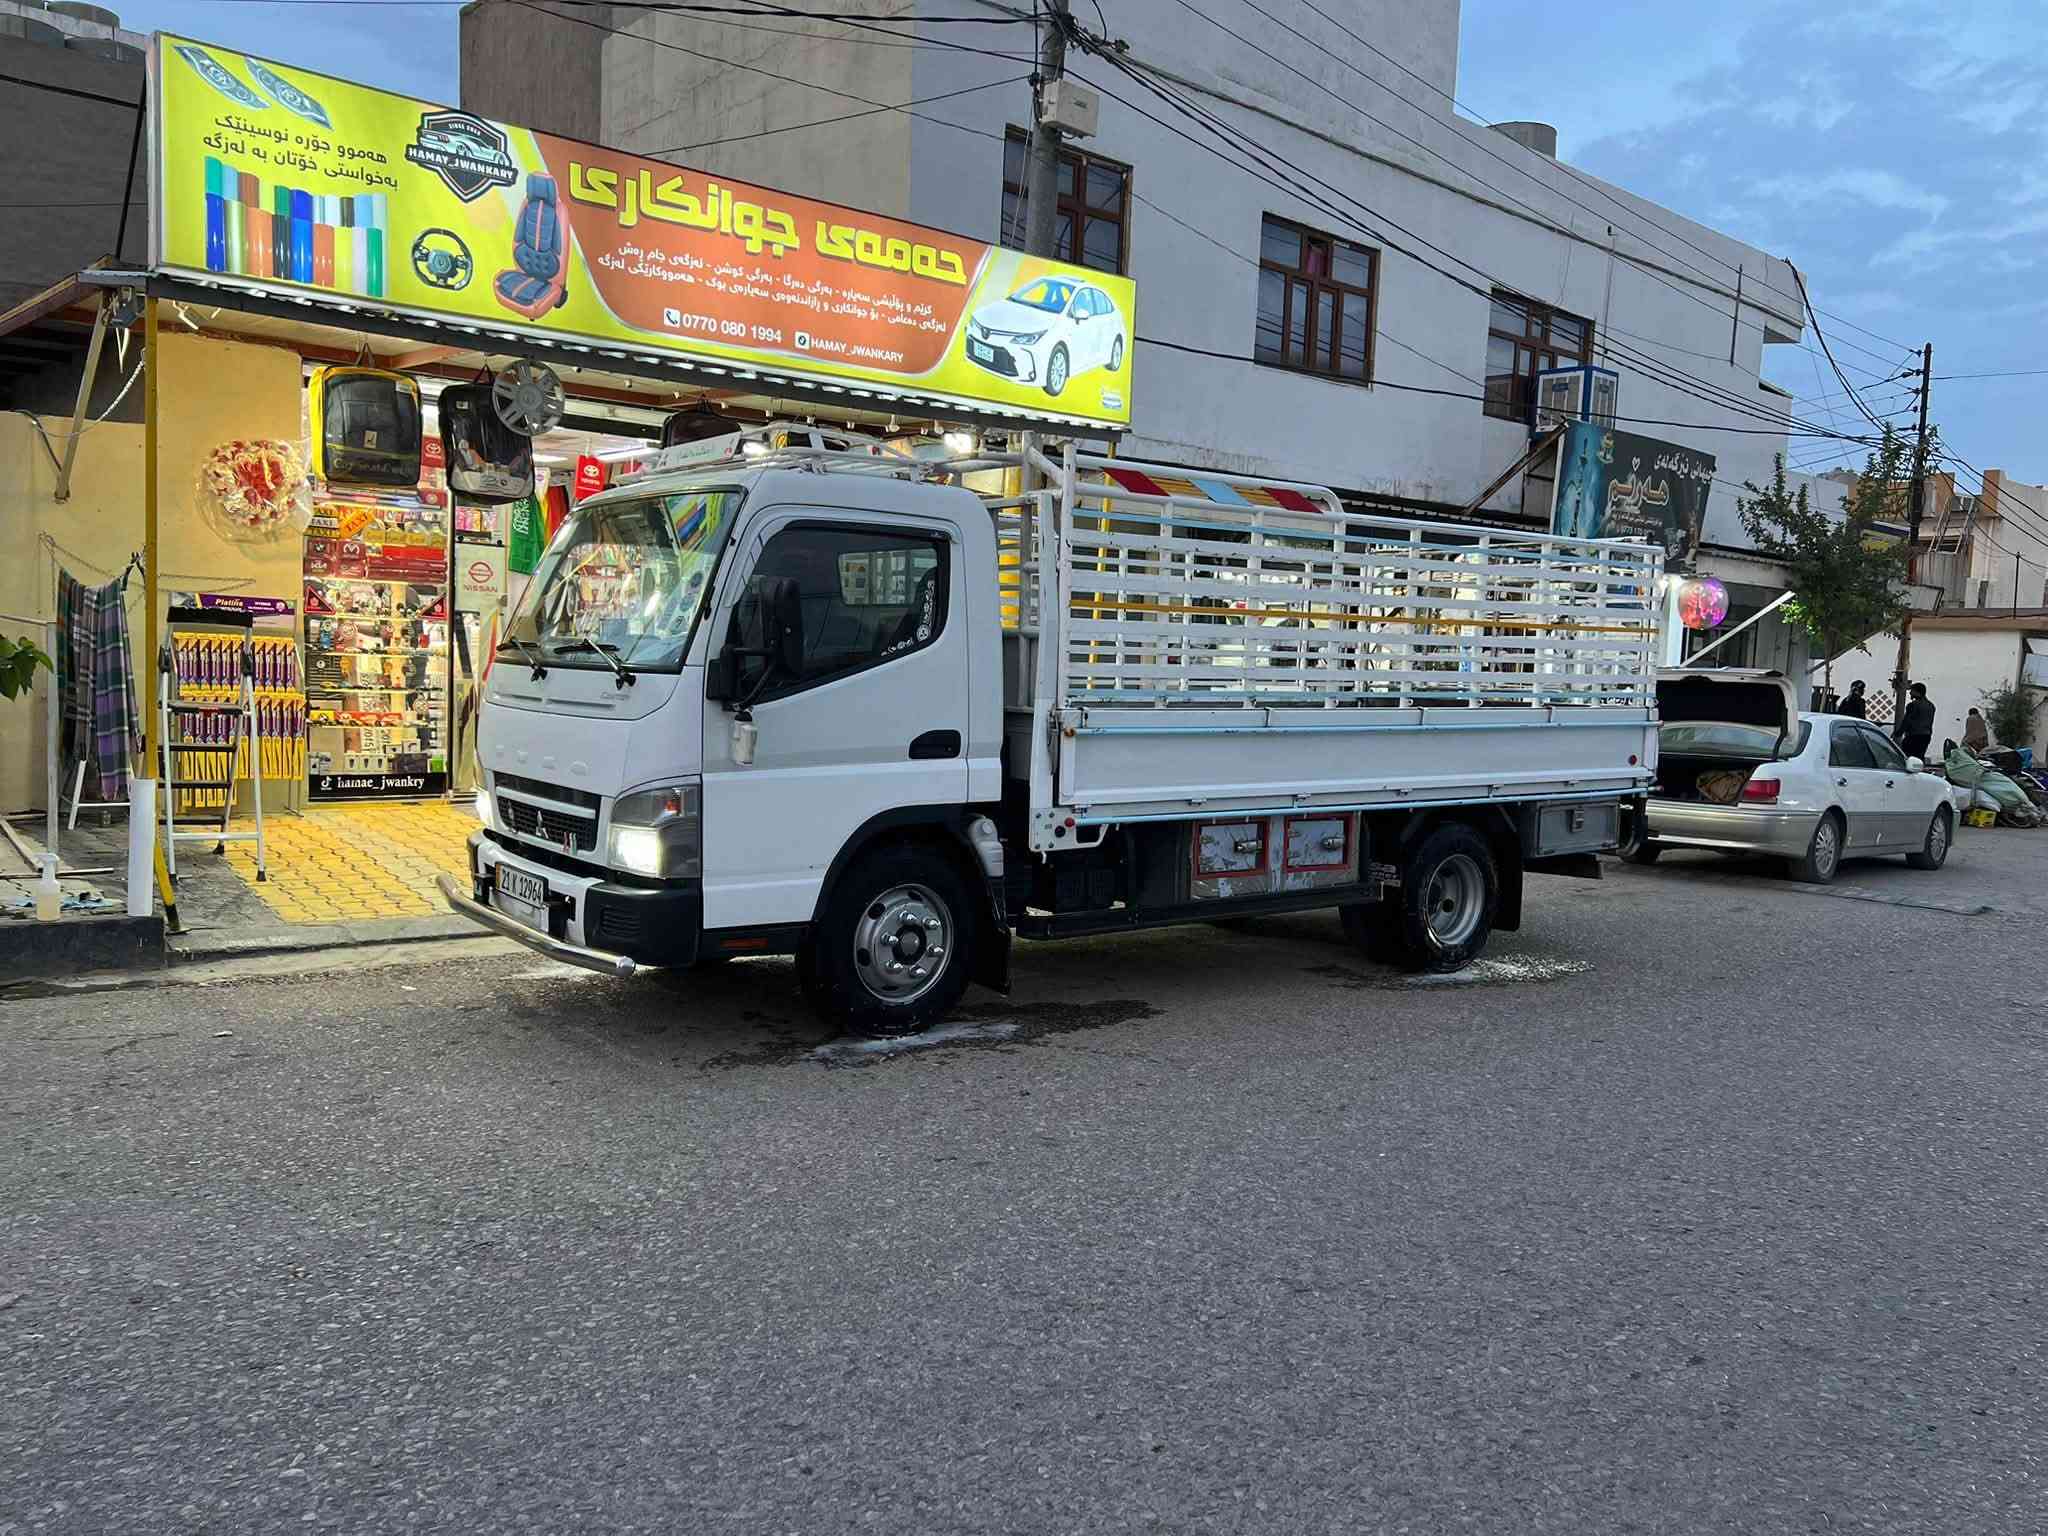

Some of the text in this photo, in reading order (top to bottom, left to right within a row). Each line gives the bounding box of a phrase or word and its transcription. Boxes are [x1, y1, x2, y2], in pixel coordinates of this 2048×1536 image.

[203, 133, 245, 154] لەزگە
[295, 134, 331, 154] جۆرە
[252, 147, 267, 163] بە
[274, 150, 318, 171] خۆتان
[337, 145, 387, 164] هەموو
[569, 161, 968, 285] حەمەی جوانکاری
[682, 314, 783, 343] 0770 080 1994
[810, 337, 904, 363] HAMAY_JWANKARY
[463, 583, 498, 593] NISSAN
[501, 868, 510, 891] 21
[519, 876, 543, 905] 12964
